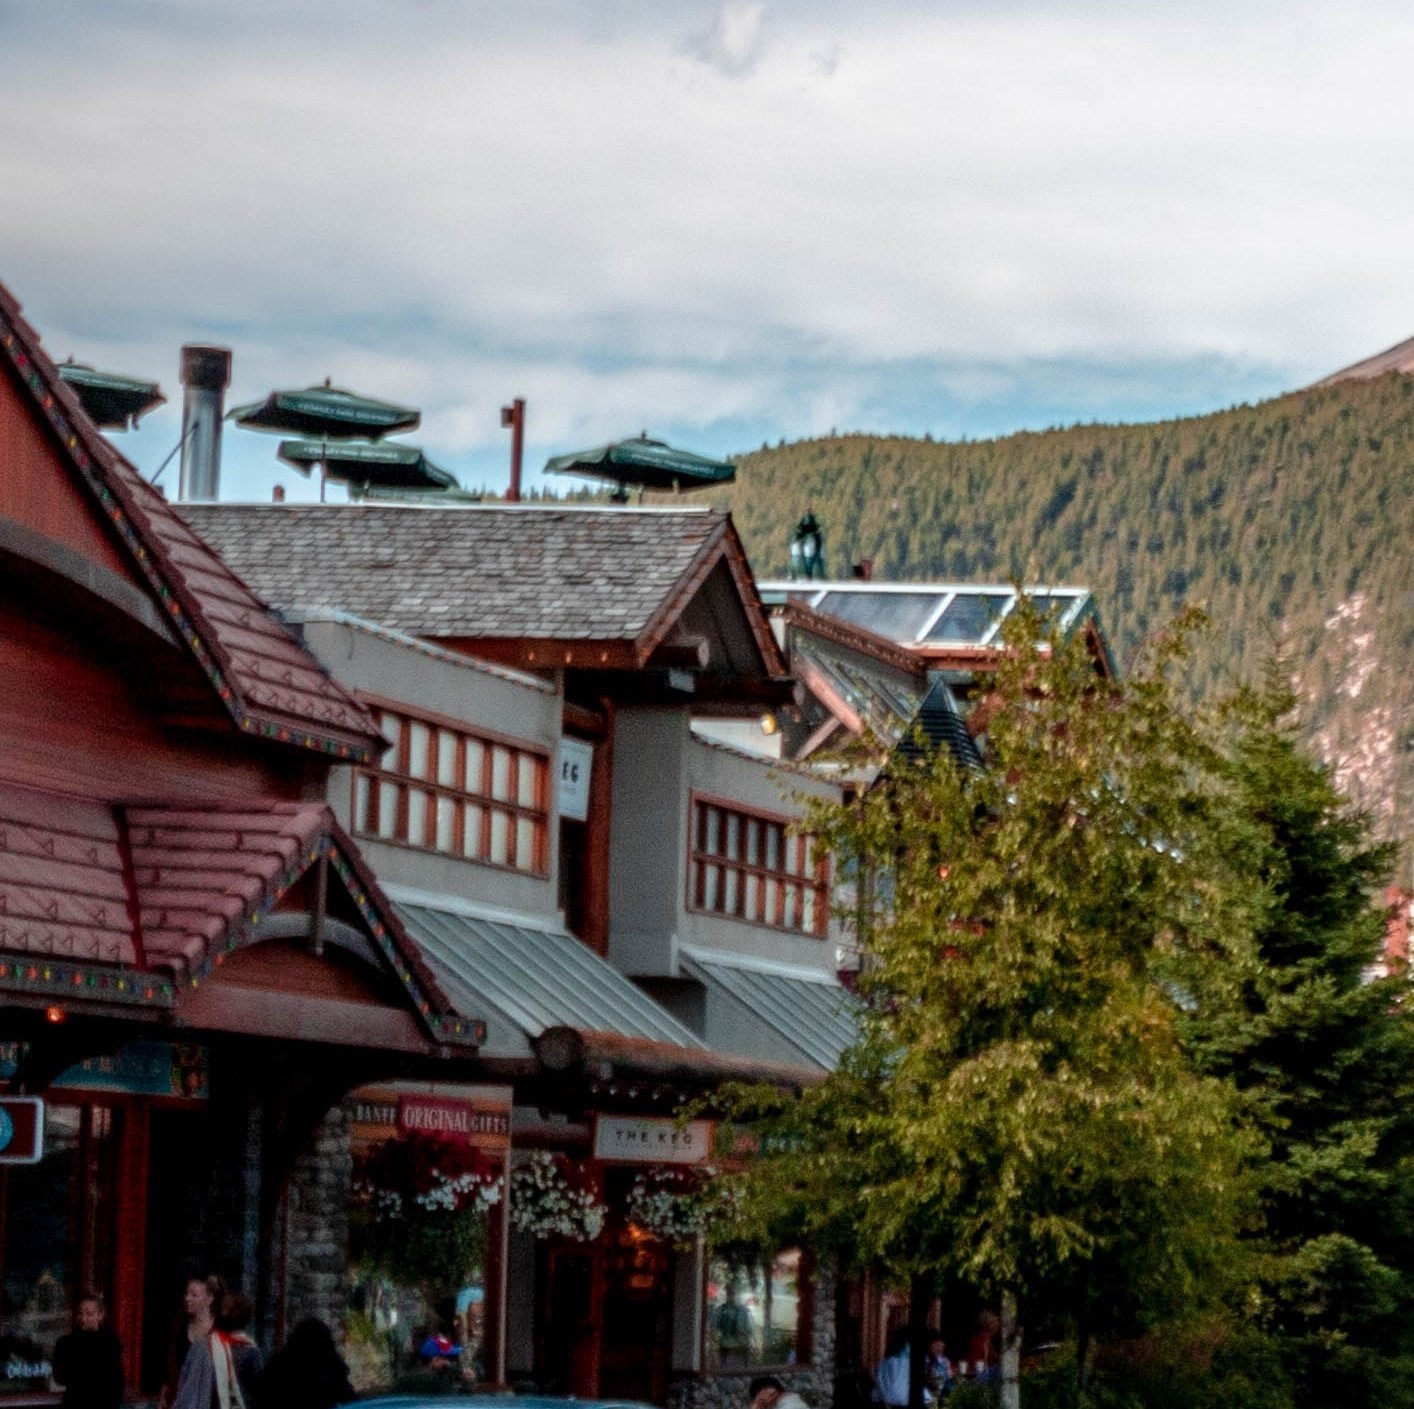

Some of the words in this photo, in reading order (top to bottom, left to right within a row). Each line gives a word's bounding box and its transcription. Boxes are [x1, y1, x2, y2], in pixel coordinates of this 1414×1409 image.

[356, 1104, 395, 1124] BANFF
[405, 1105, 470, 1132] ORIGINAL
[471, 1116, 508, 1133] GIFTS
[615, 1130, 649, 1143] THE
